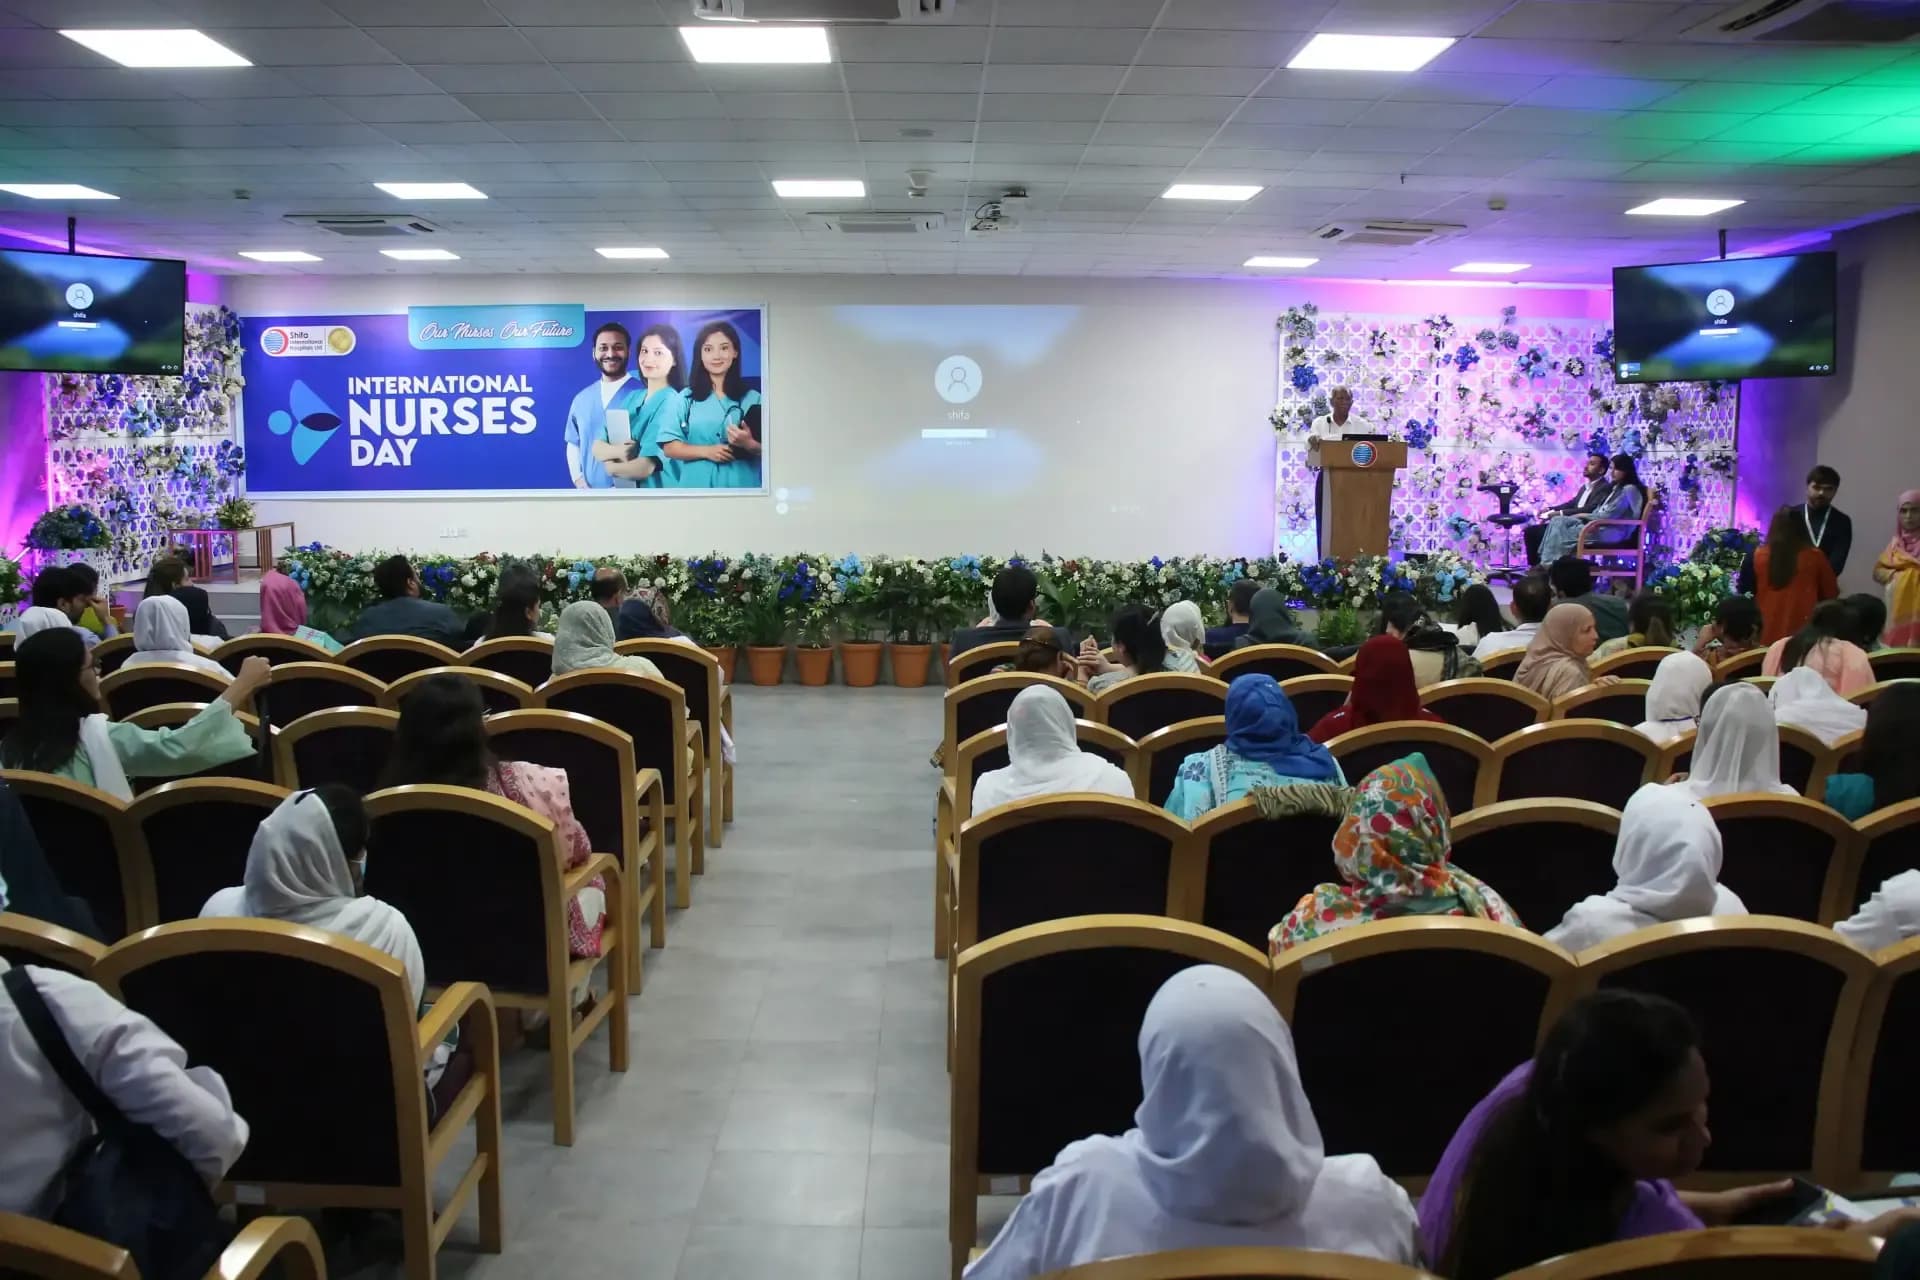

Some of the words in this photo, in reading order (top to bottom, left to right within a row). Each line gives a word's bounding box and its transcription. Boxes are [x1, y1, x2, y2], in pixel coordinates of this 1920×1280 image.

[289, 331, 309, 339] Shifa
[420, 322, 448, 341] Our
[450, 322, 495, 339] Nurses
[500, 321, 529, 339] Our
[530, 320, 573, 338] Future
[348, 374, 533, 395] INTERNATIONAL
[349, 396, 537, 437] NURSES
[947, 408, 970, 420] shifa
[350, 438, 418, 467] DAY
